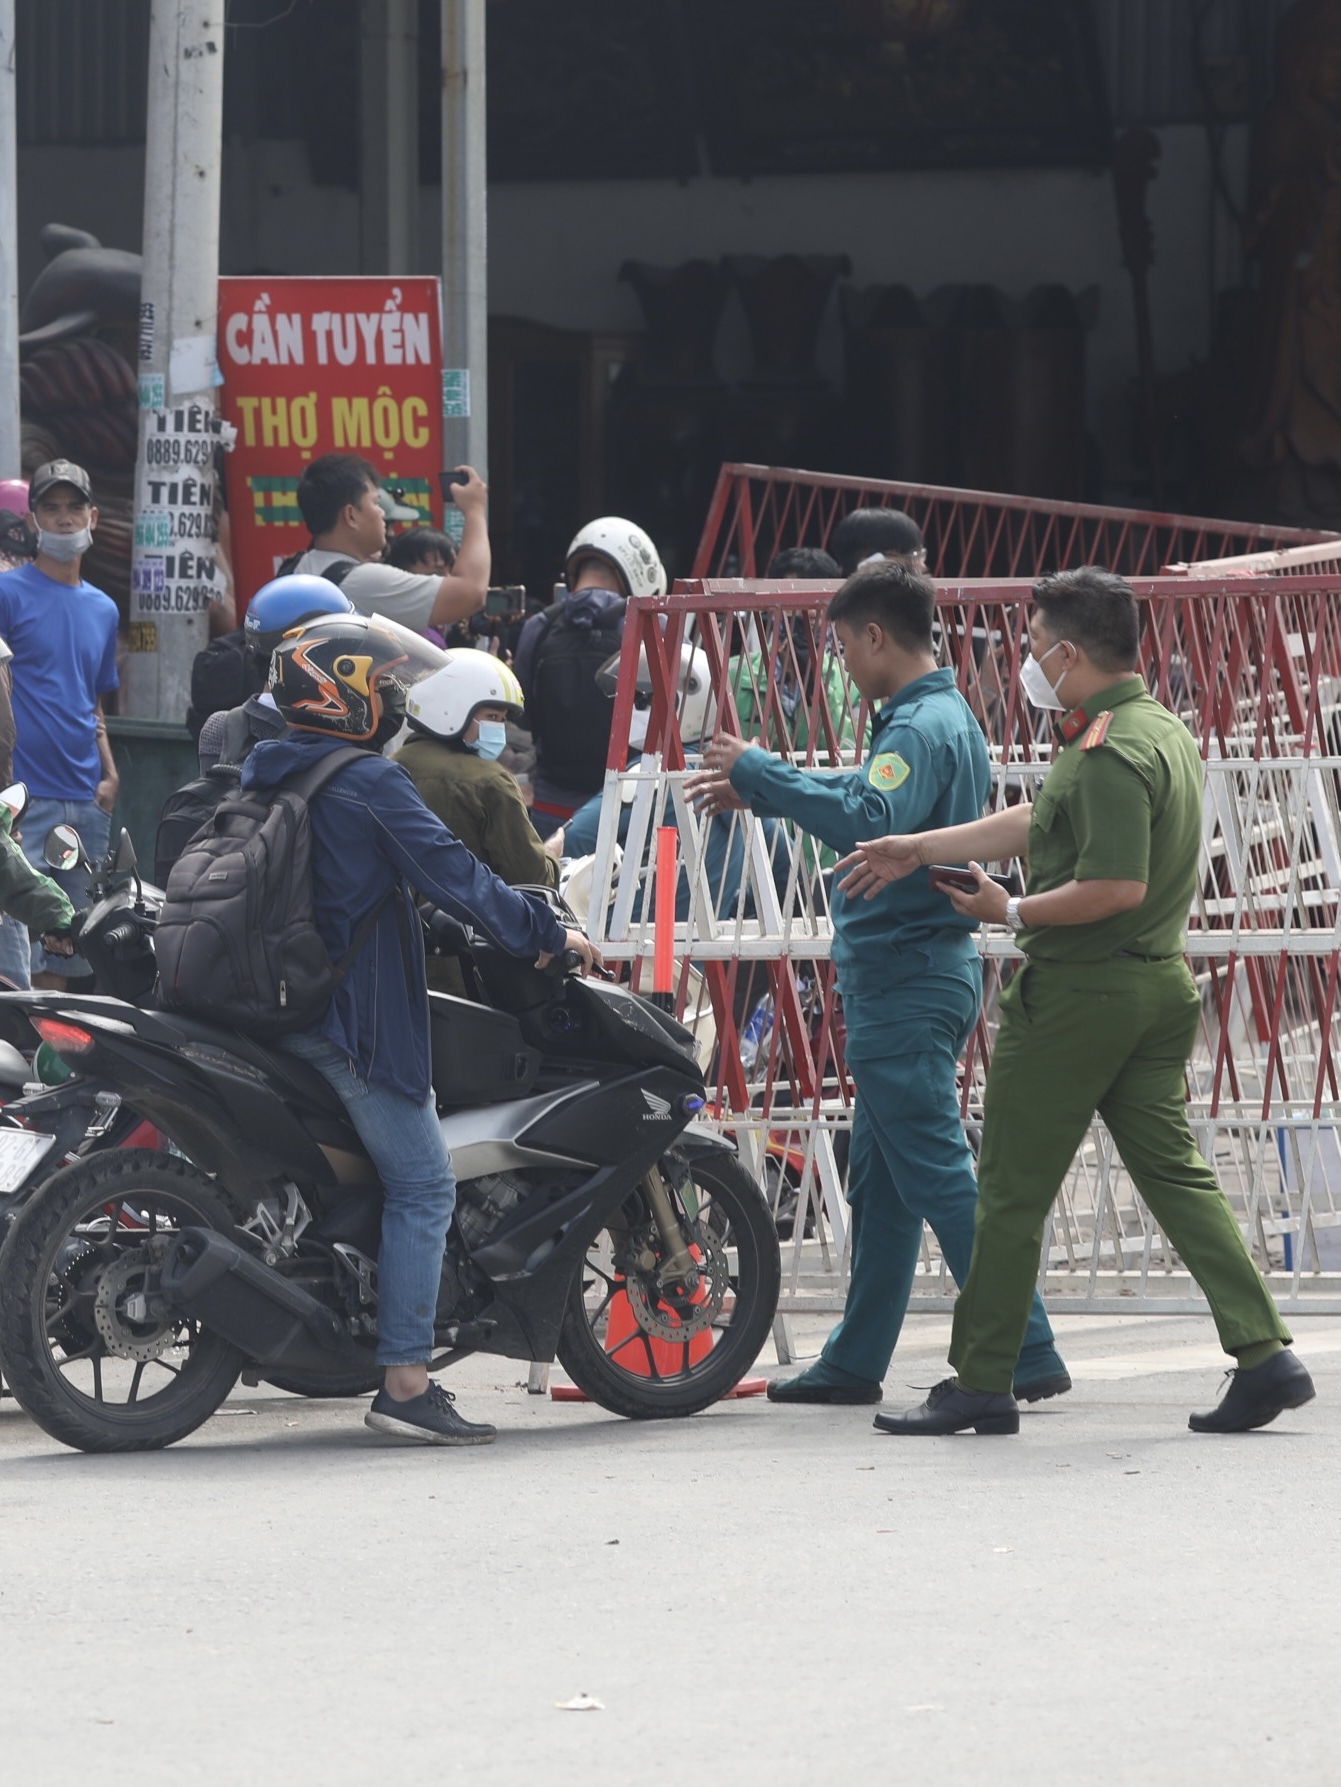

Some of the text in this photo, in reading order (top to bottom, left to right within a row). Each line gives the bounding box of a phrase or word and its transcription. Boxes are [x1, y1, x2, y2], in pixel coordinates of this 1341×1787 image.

[226, 287, 431, 366] CẦN TUYỂN
[236, 392, 318, 459] THỢ
[332, 386, 430, 459] MỘC
[642, 1113, 672, 1121] HONDA
